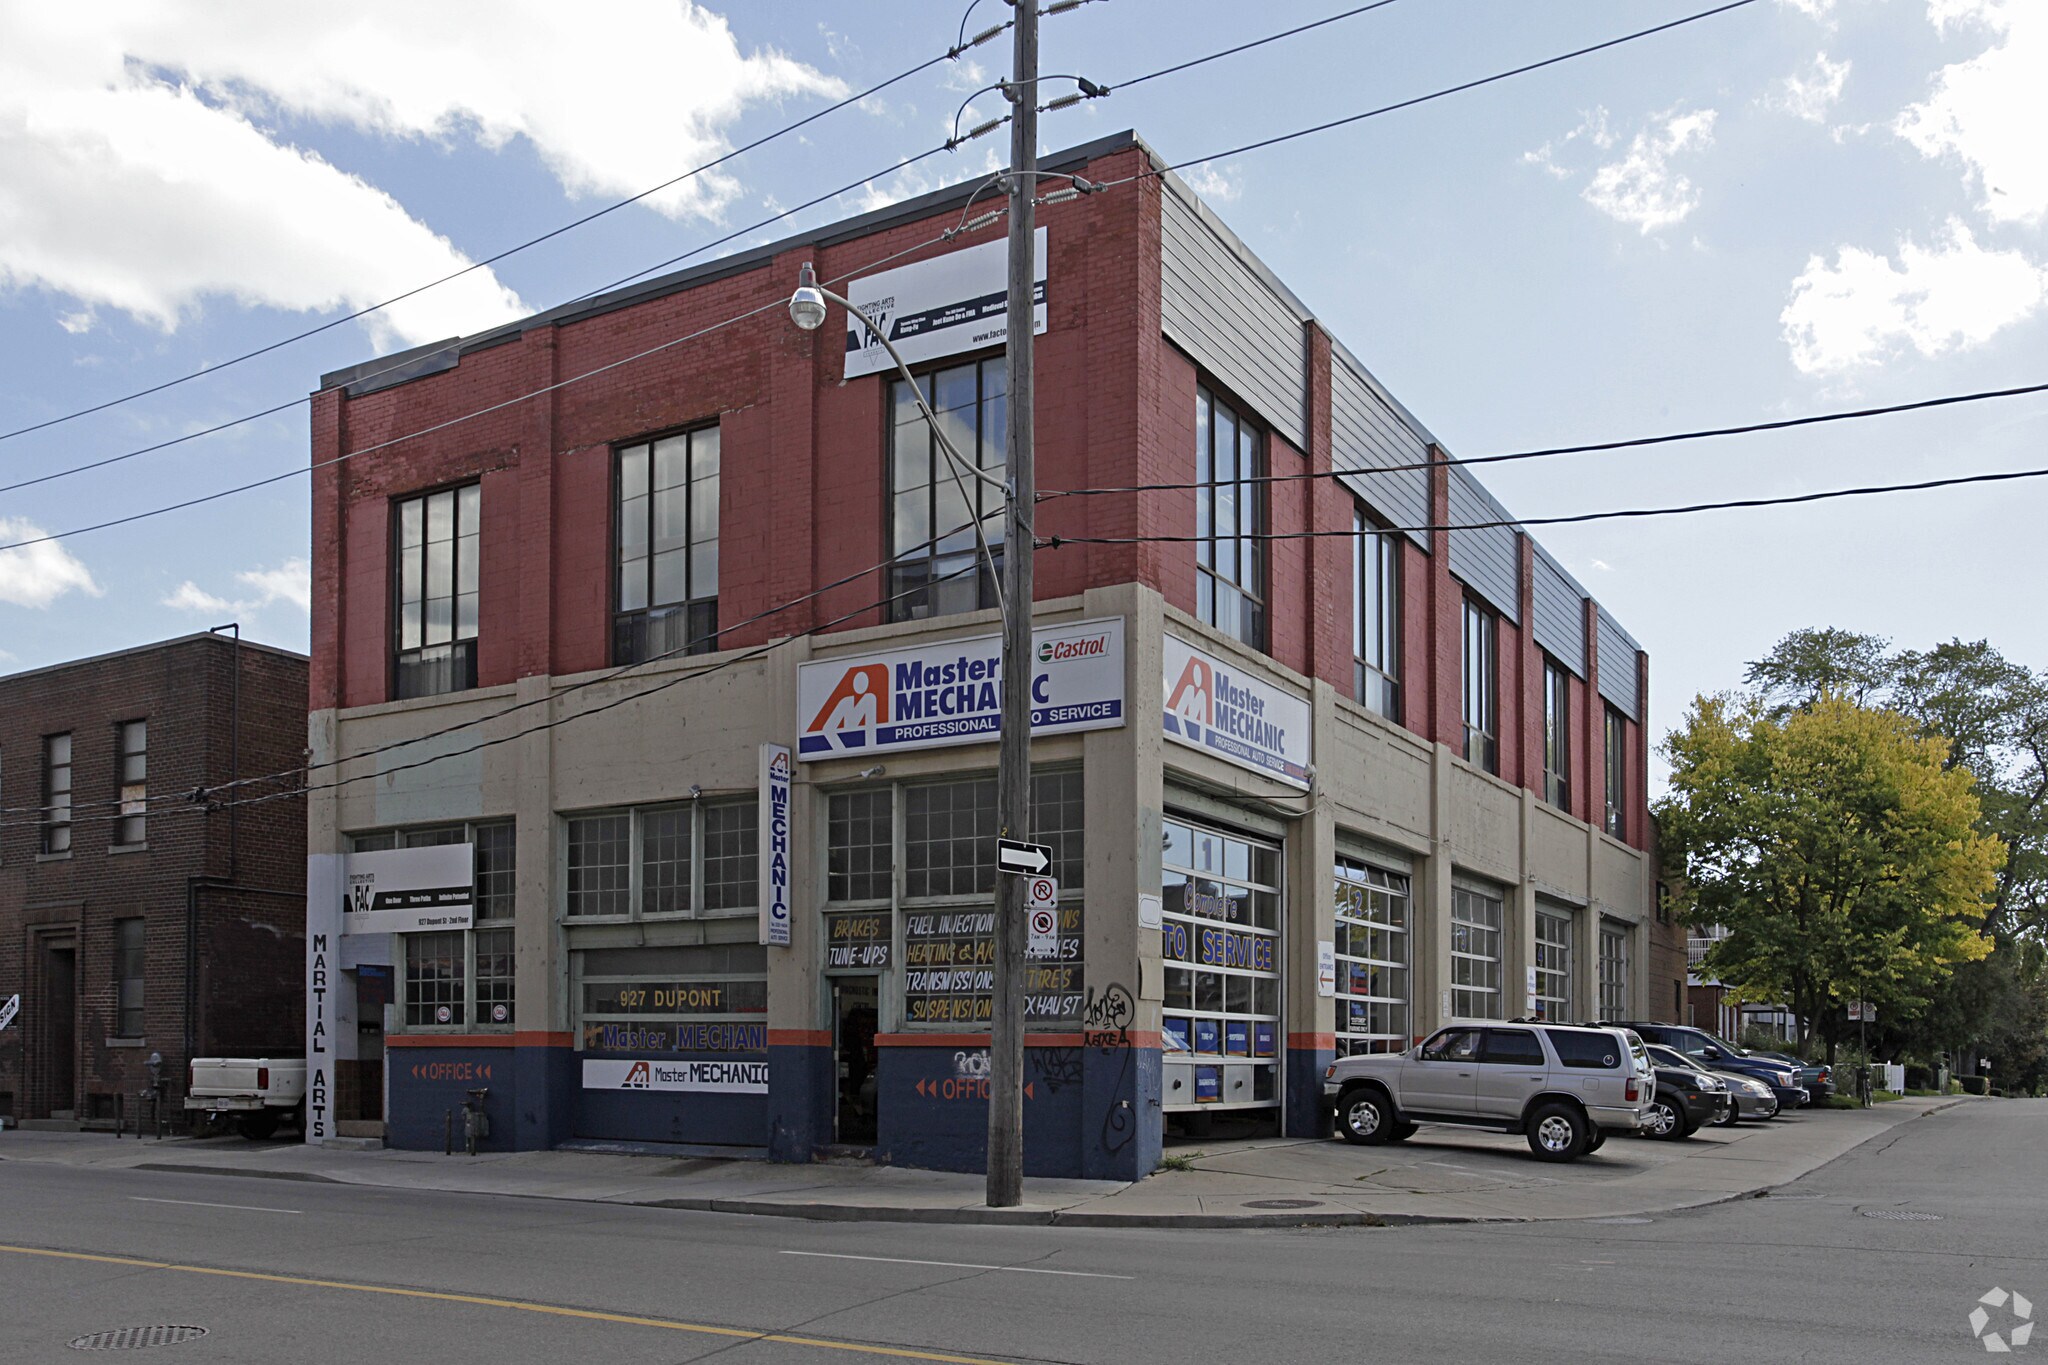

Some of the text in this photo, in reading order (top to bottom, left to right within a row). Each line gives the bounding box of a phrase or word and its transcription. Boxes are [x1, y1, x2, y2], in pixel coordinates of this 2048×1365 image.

[1054, 636, 1105, 660] Castrol
[895, 656, 1000, 691] Master
[895, 673, 1050, 721] MECHAC
[1215, 671, 1265, 717] Master
[1049, 703, 1112, 722] SERVICE
[895, 717, 996, 740] PROFESSIONAL
[1215, 700, 1285, 755] MECHANIC
[1215, 735, 1251, 758] PROFESSIONAL
[1252, 753, 1265, 764] AUTO
[1266, 755, 1284, 771] SERVICE
[771, 785, 787, 920] MECHANIC
[355, 885, 370, 912] FAC
[1184, 882, 1238, 919] Complete
[834, 919, 880, 938] BRAKES
[907, 912, 995, 935] FUEL INJECTION
[829, 945, 888, 965] TUNE-UPS
[907, 943, 956, 963] HEATING
[959, 944, 974, 961] &
[1162, 922, 1272, 970] TO SERVICE
[1028, 968, 1072, 988] TIRES
[620, 989, 721, 1007] 927 DUPONT
[913, 998, 993, 1019] SUSPENSION
[1024, 995, 1082, 1015] XHAUST
[313, 934, 327, 1137] MARTIAL ARTS
[603, 1023, 767, 1050] Master MECHANI
[430, 1062, 473, 1080] OFFICE
[655, 1066, 688, 1083] Master
[942, 1078, 991, 1100] OFFIC
